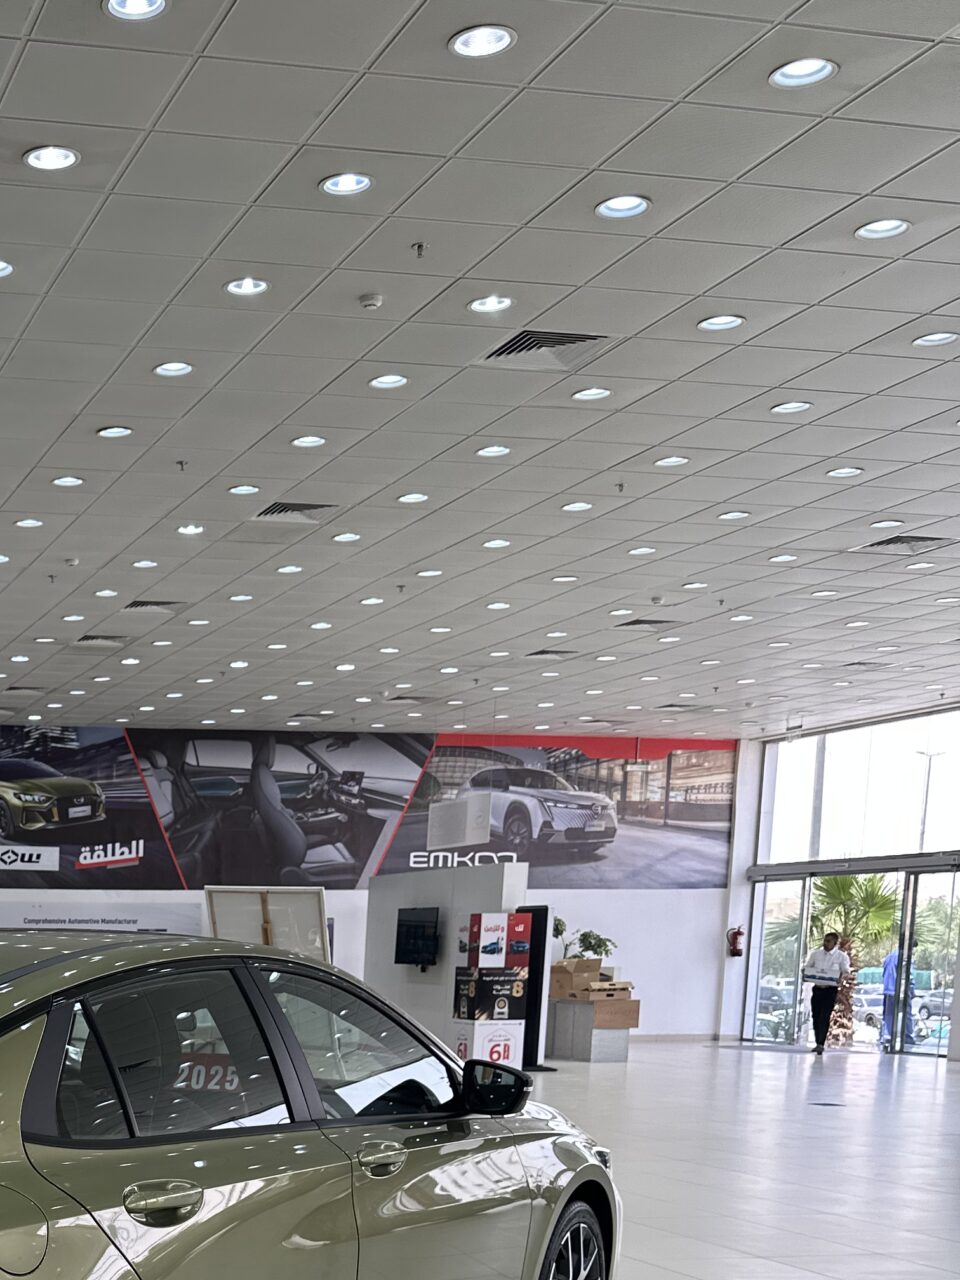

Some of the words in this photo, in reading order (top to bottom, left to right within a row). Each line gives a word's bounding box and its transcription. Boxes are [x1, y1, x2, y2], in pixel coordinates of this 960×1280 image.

[79, 839, 144, 865] الطلقة
[23, 917, 66, 925] Comprehensive
[68, 917, 100, 925] Automotive
[512, 981, 524, 997] 8
[489, 1043, 501, 1062] 6
[173, 1065, 239, 1090] 2025
